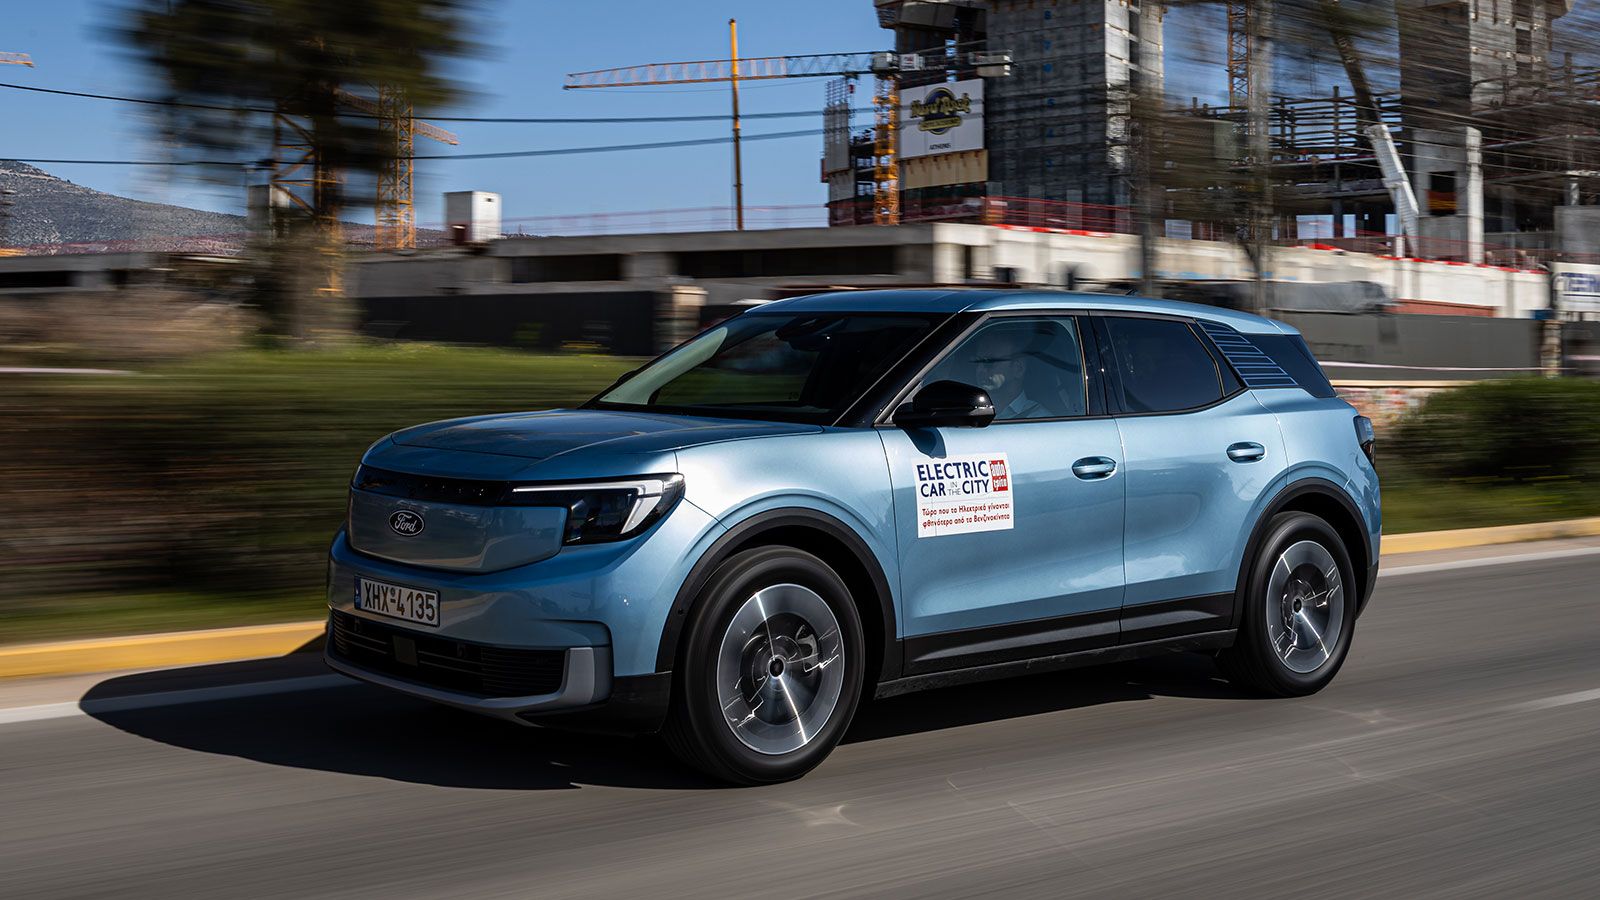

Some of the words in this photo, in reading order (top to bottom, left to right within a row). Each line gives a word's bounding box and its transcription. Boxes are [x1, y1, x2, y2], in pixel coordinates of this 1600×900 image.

[917, 461, 989, 481] ELECTRIC
[920, 482, 946, 497] CAR
[947, 488, 961, 496] THE
[962, 479, 990, 495] CITY
[395, 513, 417, 532] Ford
